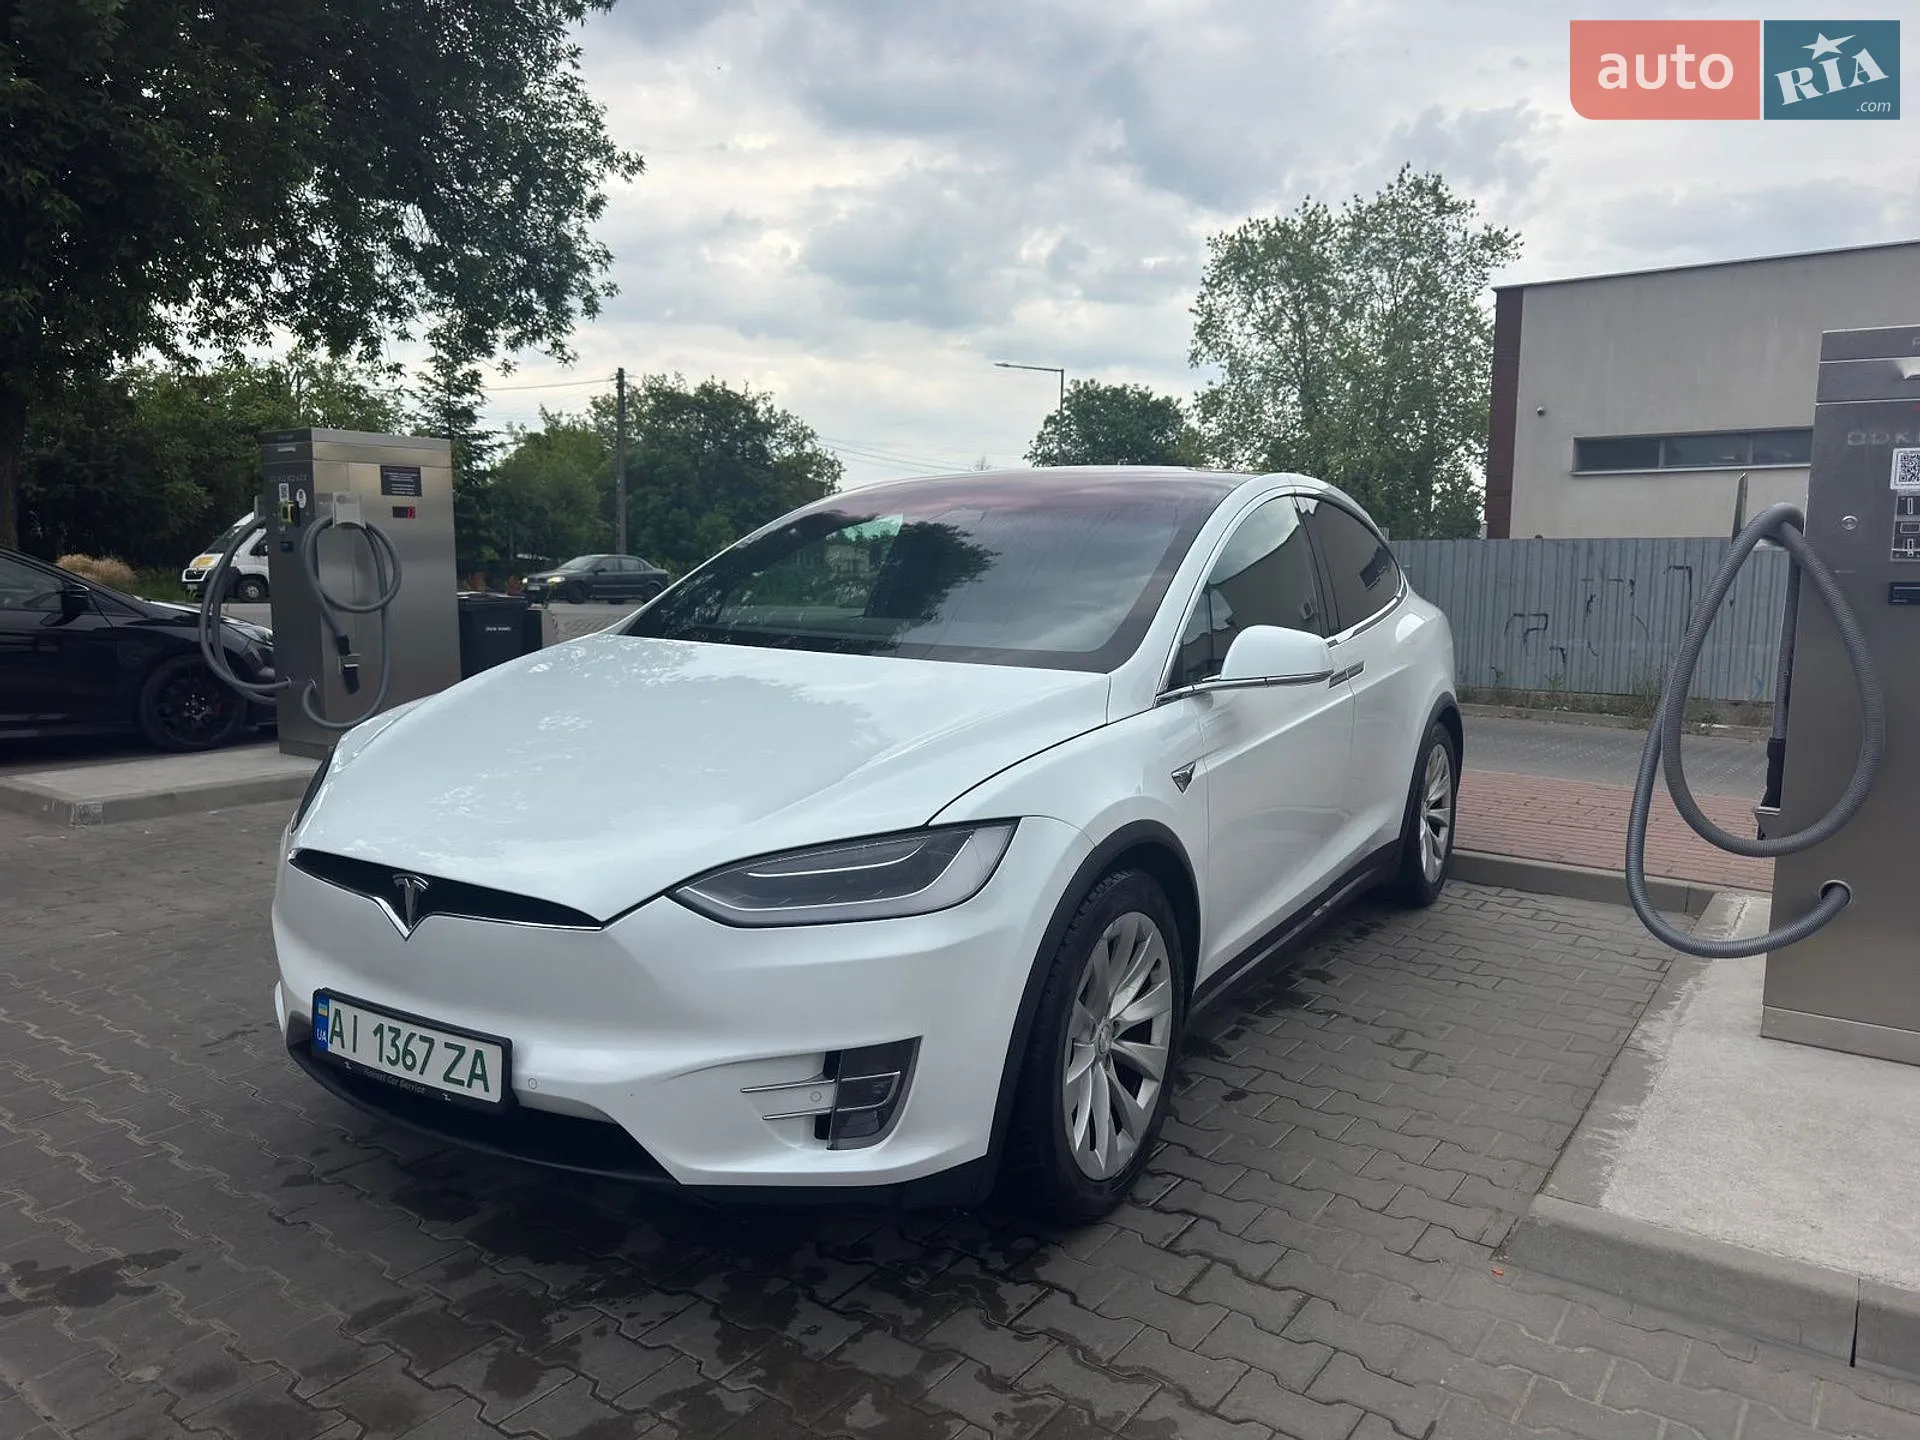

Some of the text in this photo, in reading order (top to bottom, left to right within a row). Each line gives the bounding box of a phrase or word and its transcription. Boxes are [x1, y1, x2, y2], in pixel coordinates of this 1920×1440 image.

[316, 1029, 327, 1042] UA
[329, 1008, 490, 1093] AI 1367 ZA
